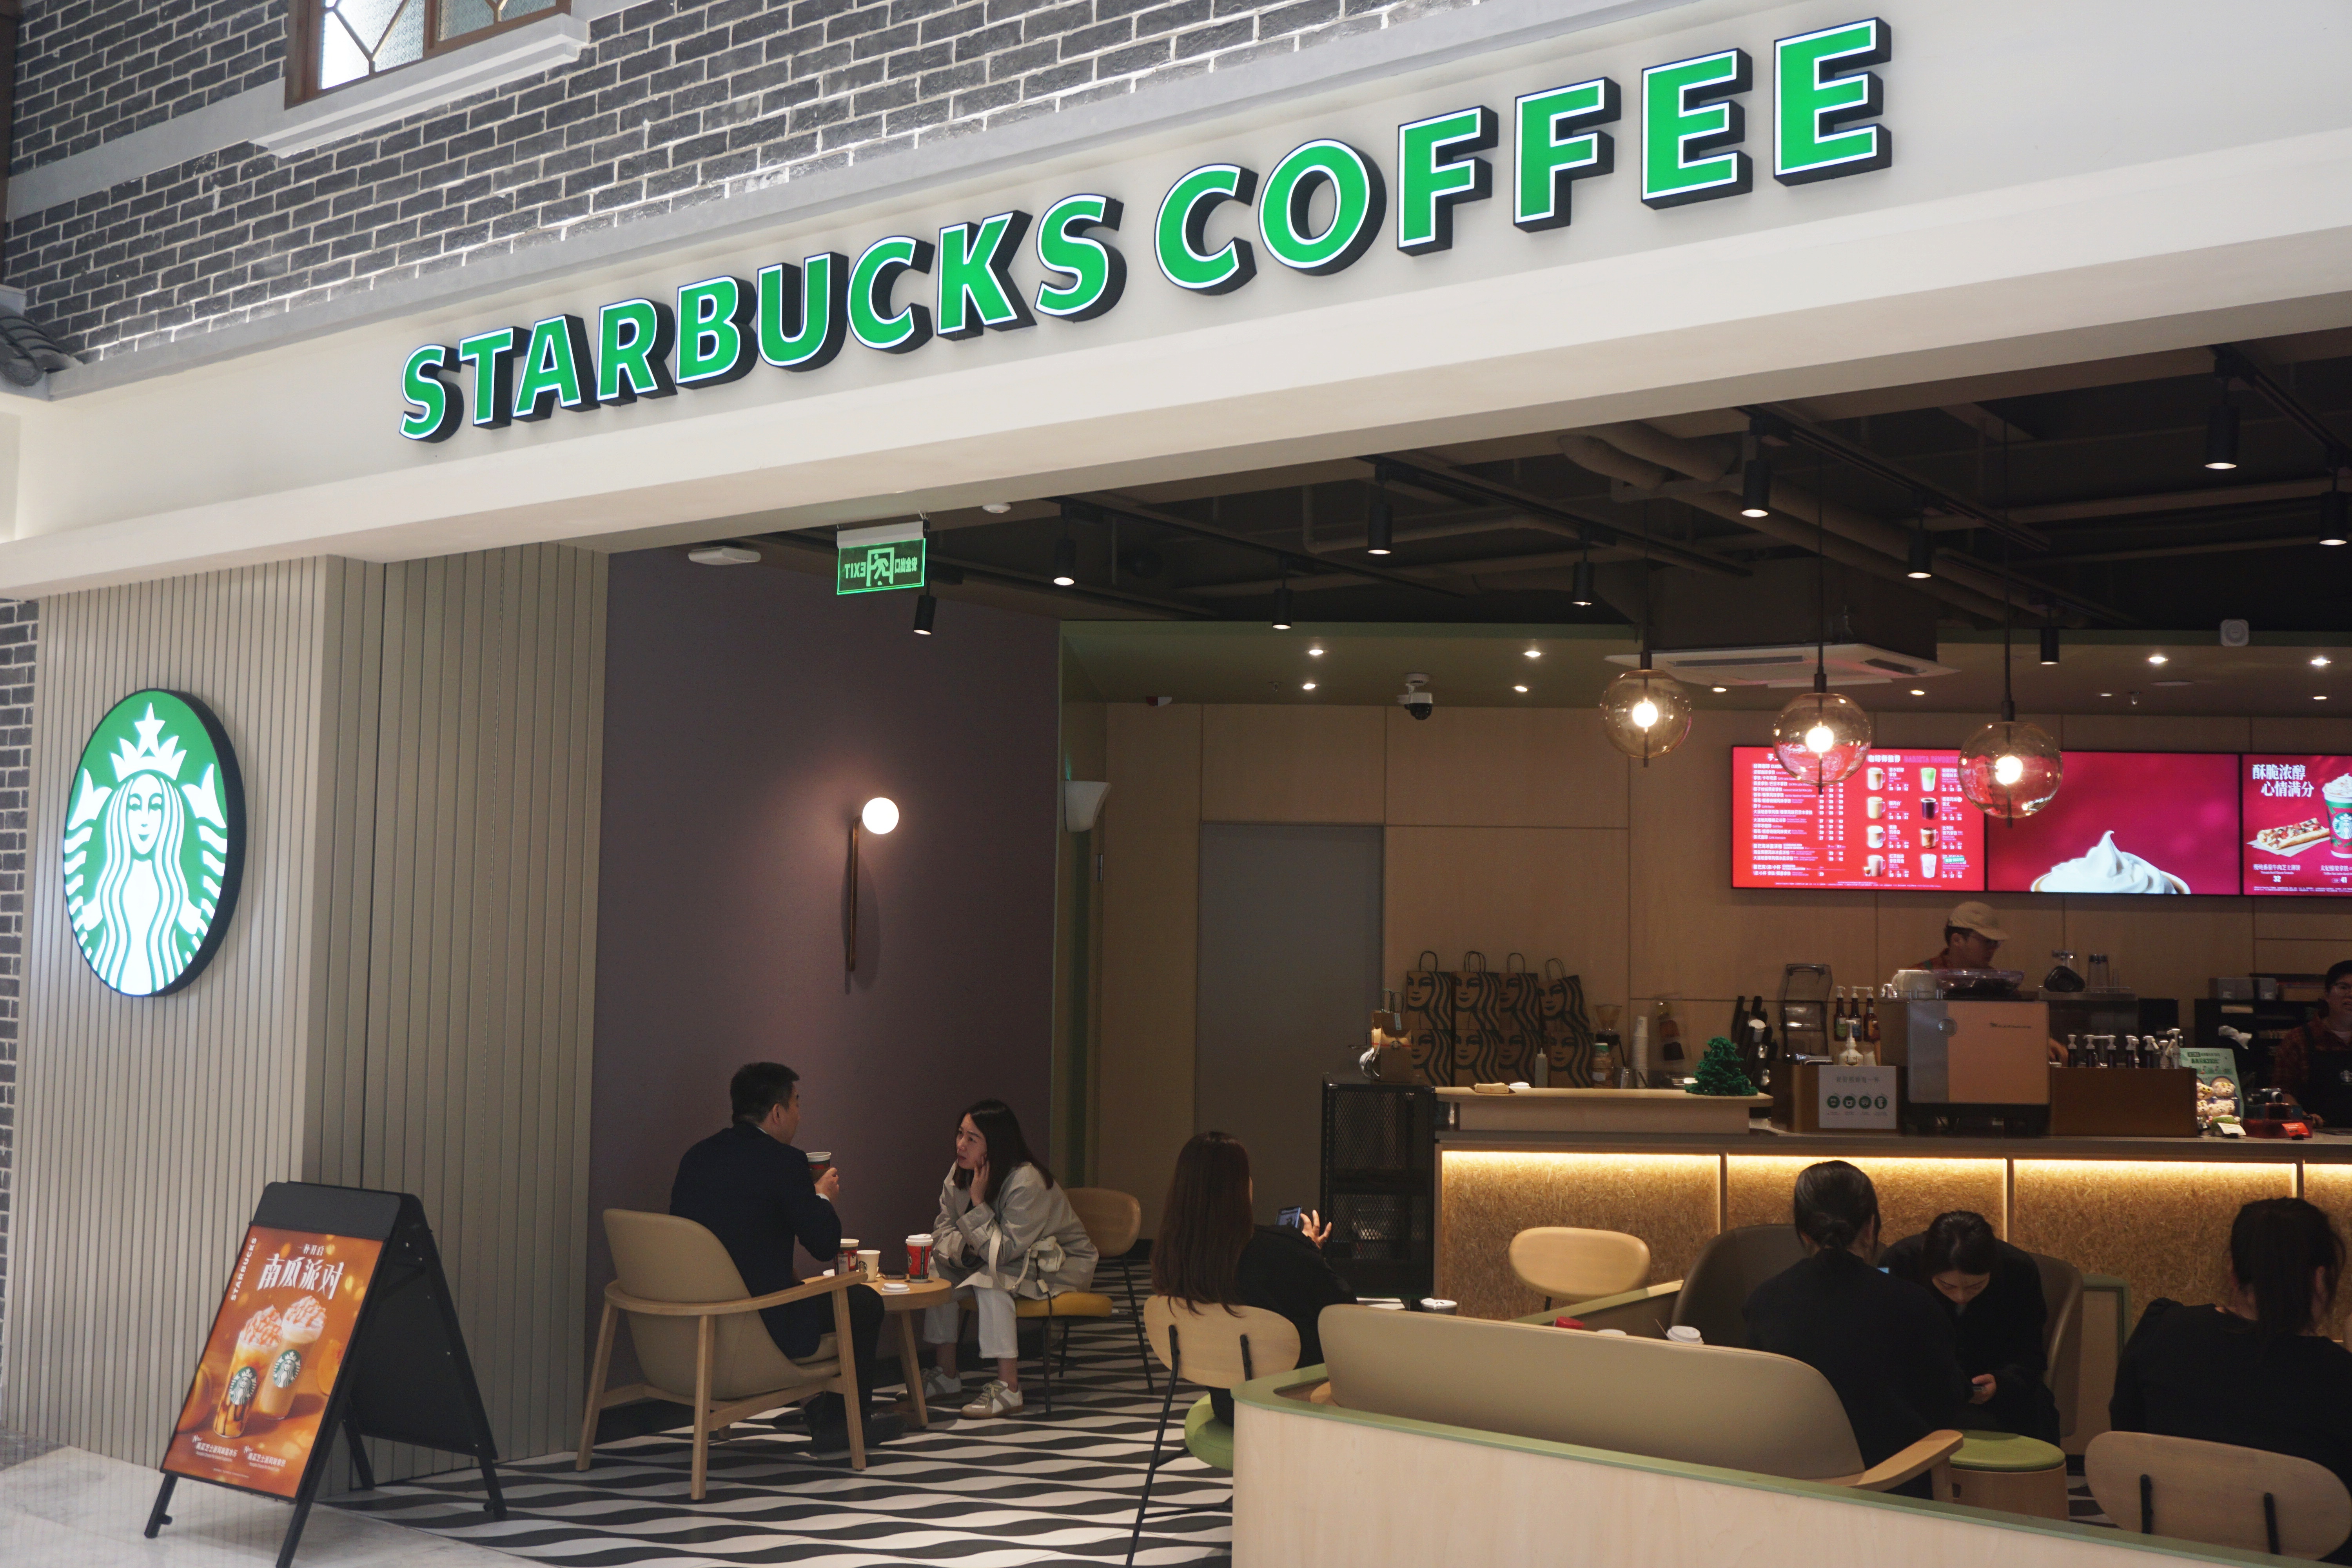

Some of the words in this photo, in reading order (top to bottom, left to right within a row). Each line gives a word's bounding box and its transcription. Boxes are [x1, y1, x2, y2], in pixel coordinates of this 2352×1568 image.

[399, 194, 1126, 443] STARBUCKS
[1154, 16, 1892, 296] COFFEE
[2252, 764, 2306, 780] 酥脆浓醇
[2261, 781, 2314, 797] 心情满分
[230, 1238, 257, 1301] STARBUCKS
[256, 1252, 344, 1300] 南瓜派对
